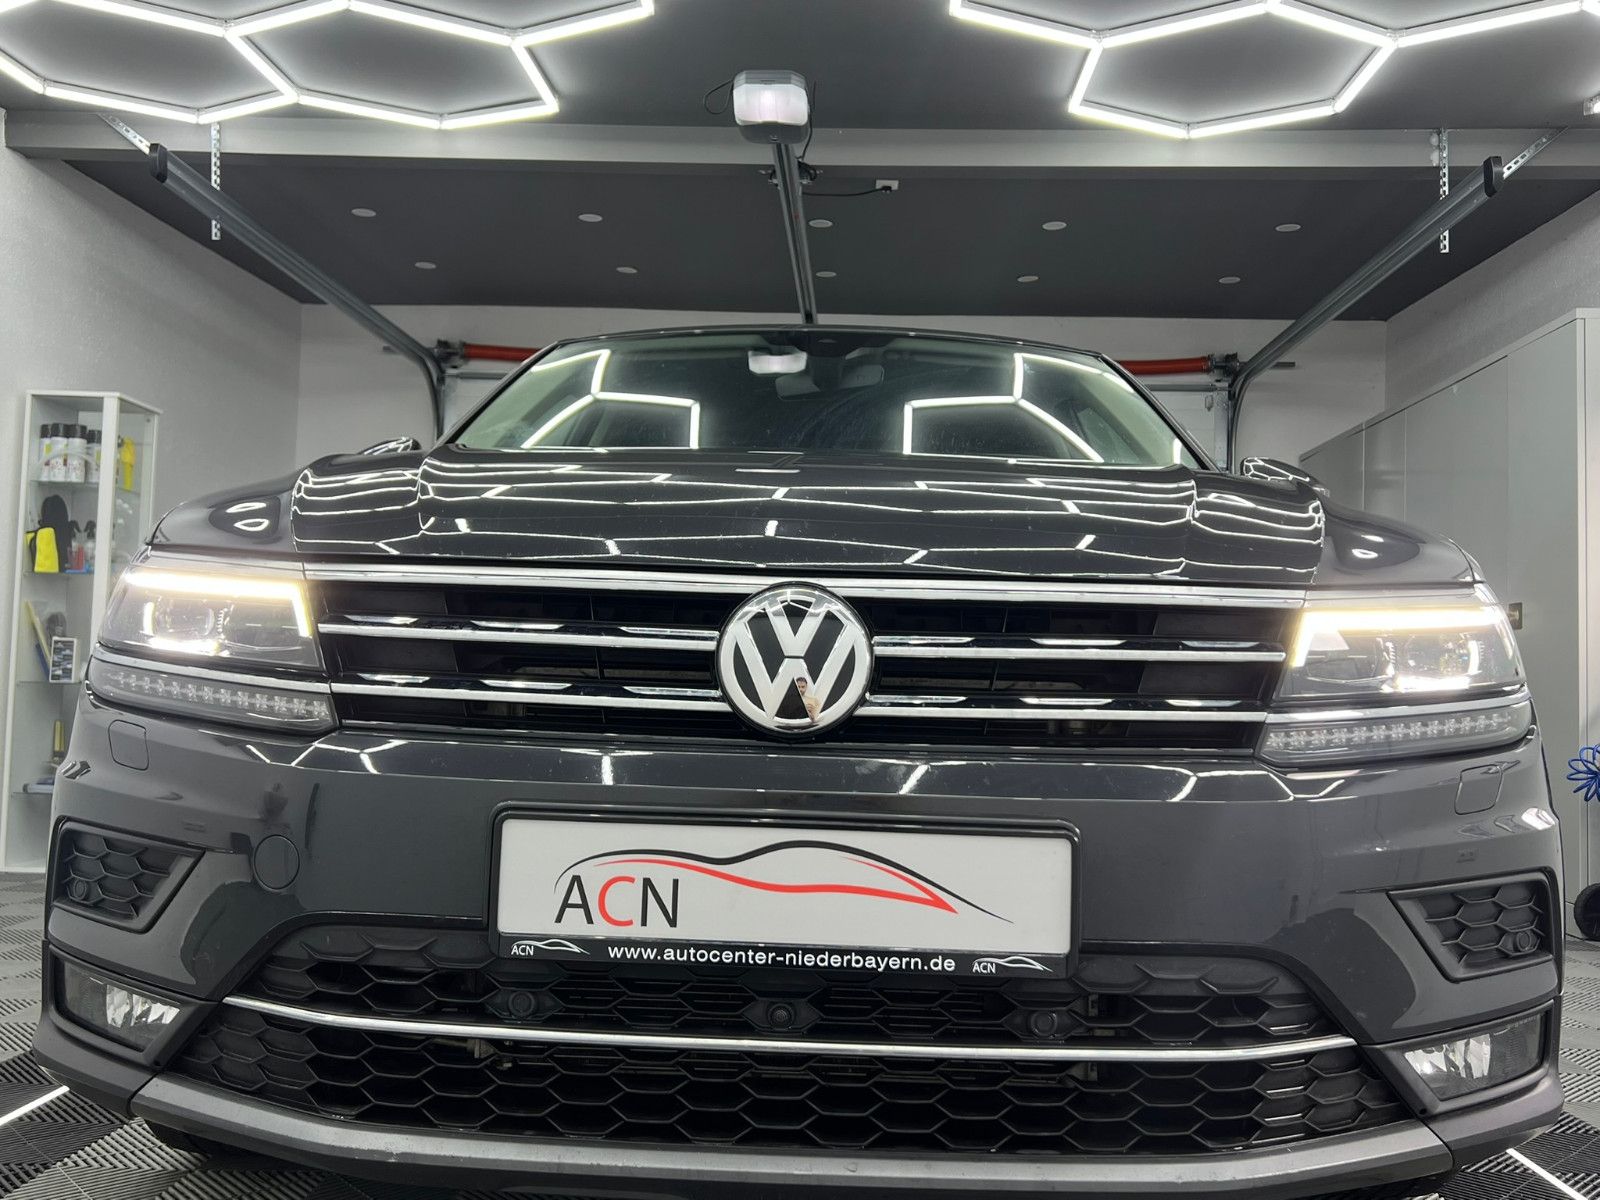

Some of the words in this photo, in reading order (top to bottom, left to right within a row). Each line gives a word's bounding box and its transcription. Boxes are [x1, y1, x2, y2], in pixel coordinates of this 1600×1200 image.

[554, 874, 679, 928] ACN
[510, 945, 534, 956] ACN
[607, 945, 956, 972] www.autocenter-niederbayern.de
[972, 962, 996, 974] ACN
